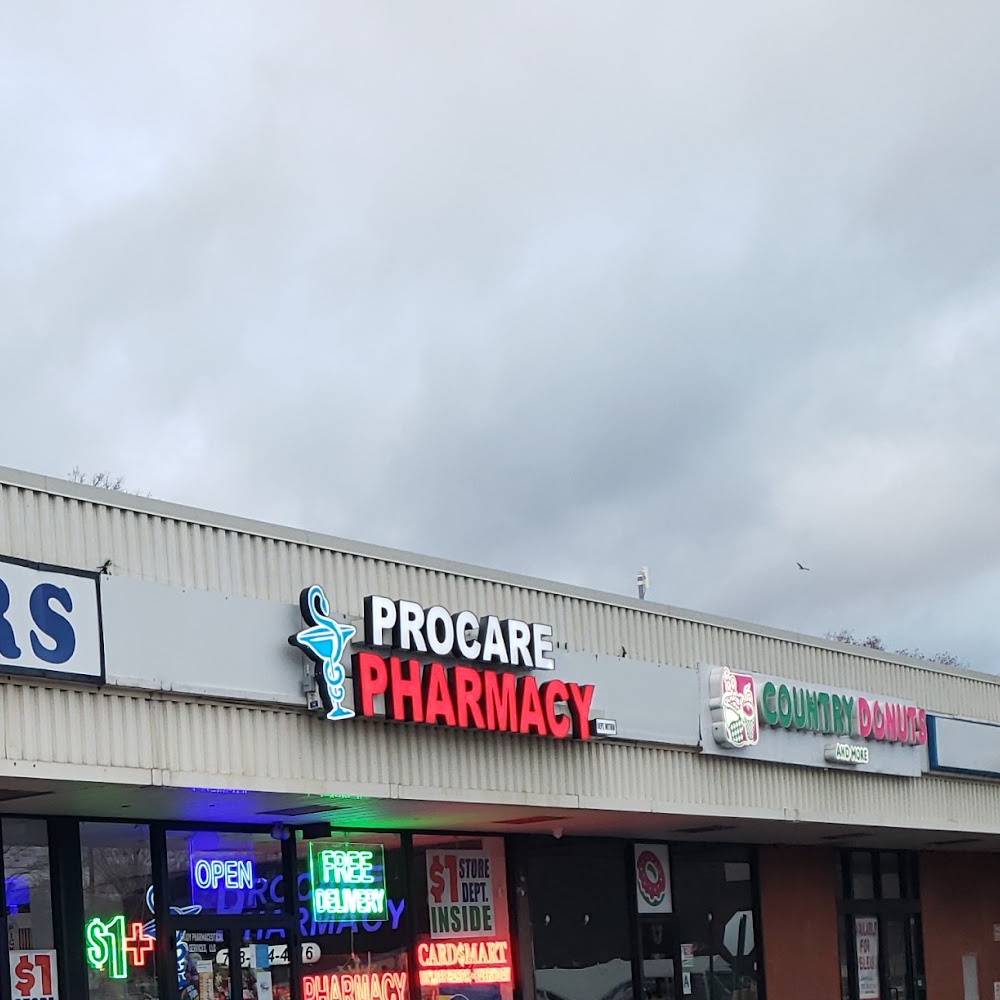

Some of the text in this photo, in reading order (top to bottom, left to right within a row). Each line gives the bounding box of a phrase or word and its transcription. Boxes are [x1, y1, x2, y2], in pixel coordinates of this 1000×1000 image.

[366, 595, 555, 670] PROCARE
[354, 651, 595, 740] PHARMACY
[762, 681, 928, 745] COUNTRY DONUTS
[836, 743, 868, 762] AND MORE
[195, 859, 253, 889] OPEN
[321, 849, 375, 883] FREE
[430, 854, 490, 903] $1 STORE
[315, 887, 385, 914] DELIVERY
[462, 882, 489, 903] DEPT.
[431, 905, 493, 933] INSIDE
[15, 955, 52, 996] $1
[684, 975, 689, 988] A
